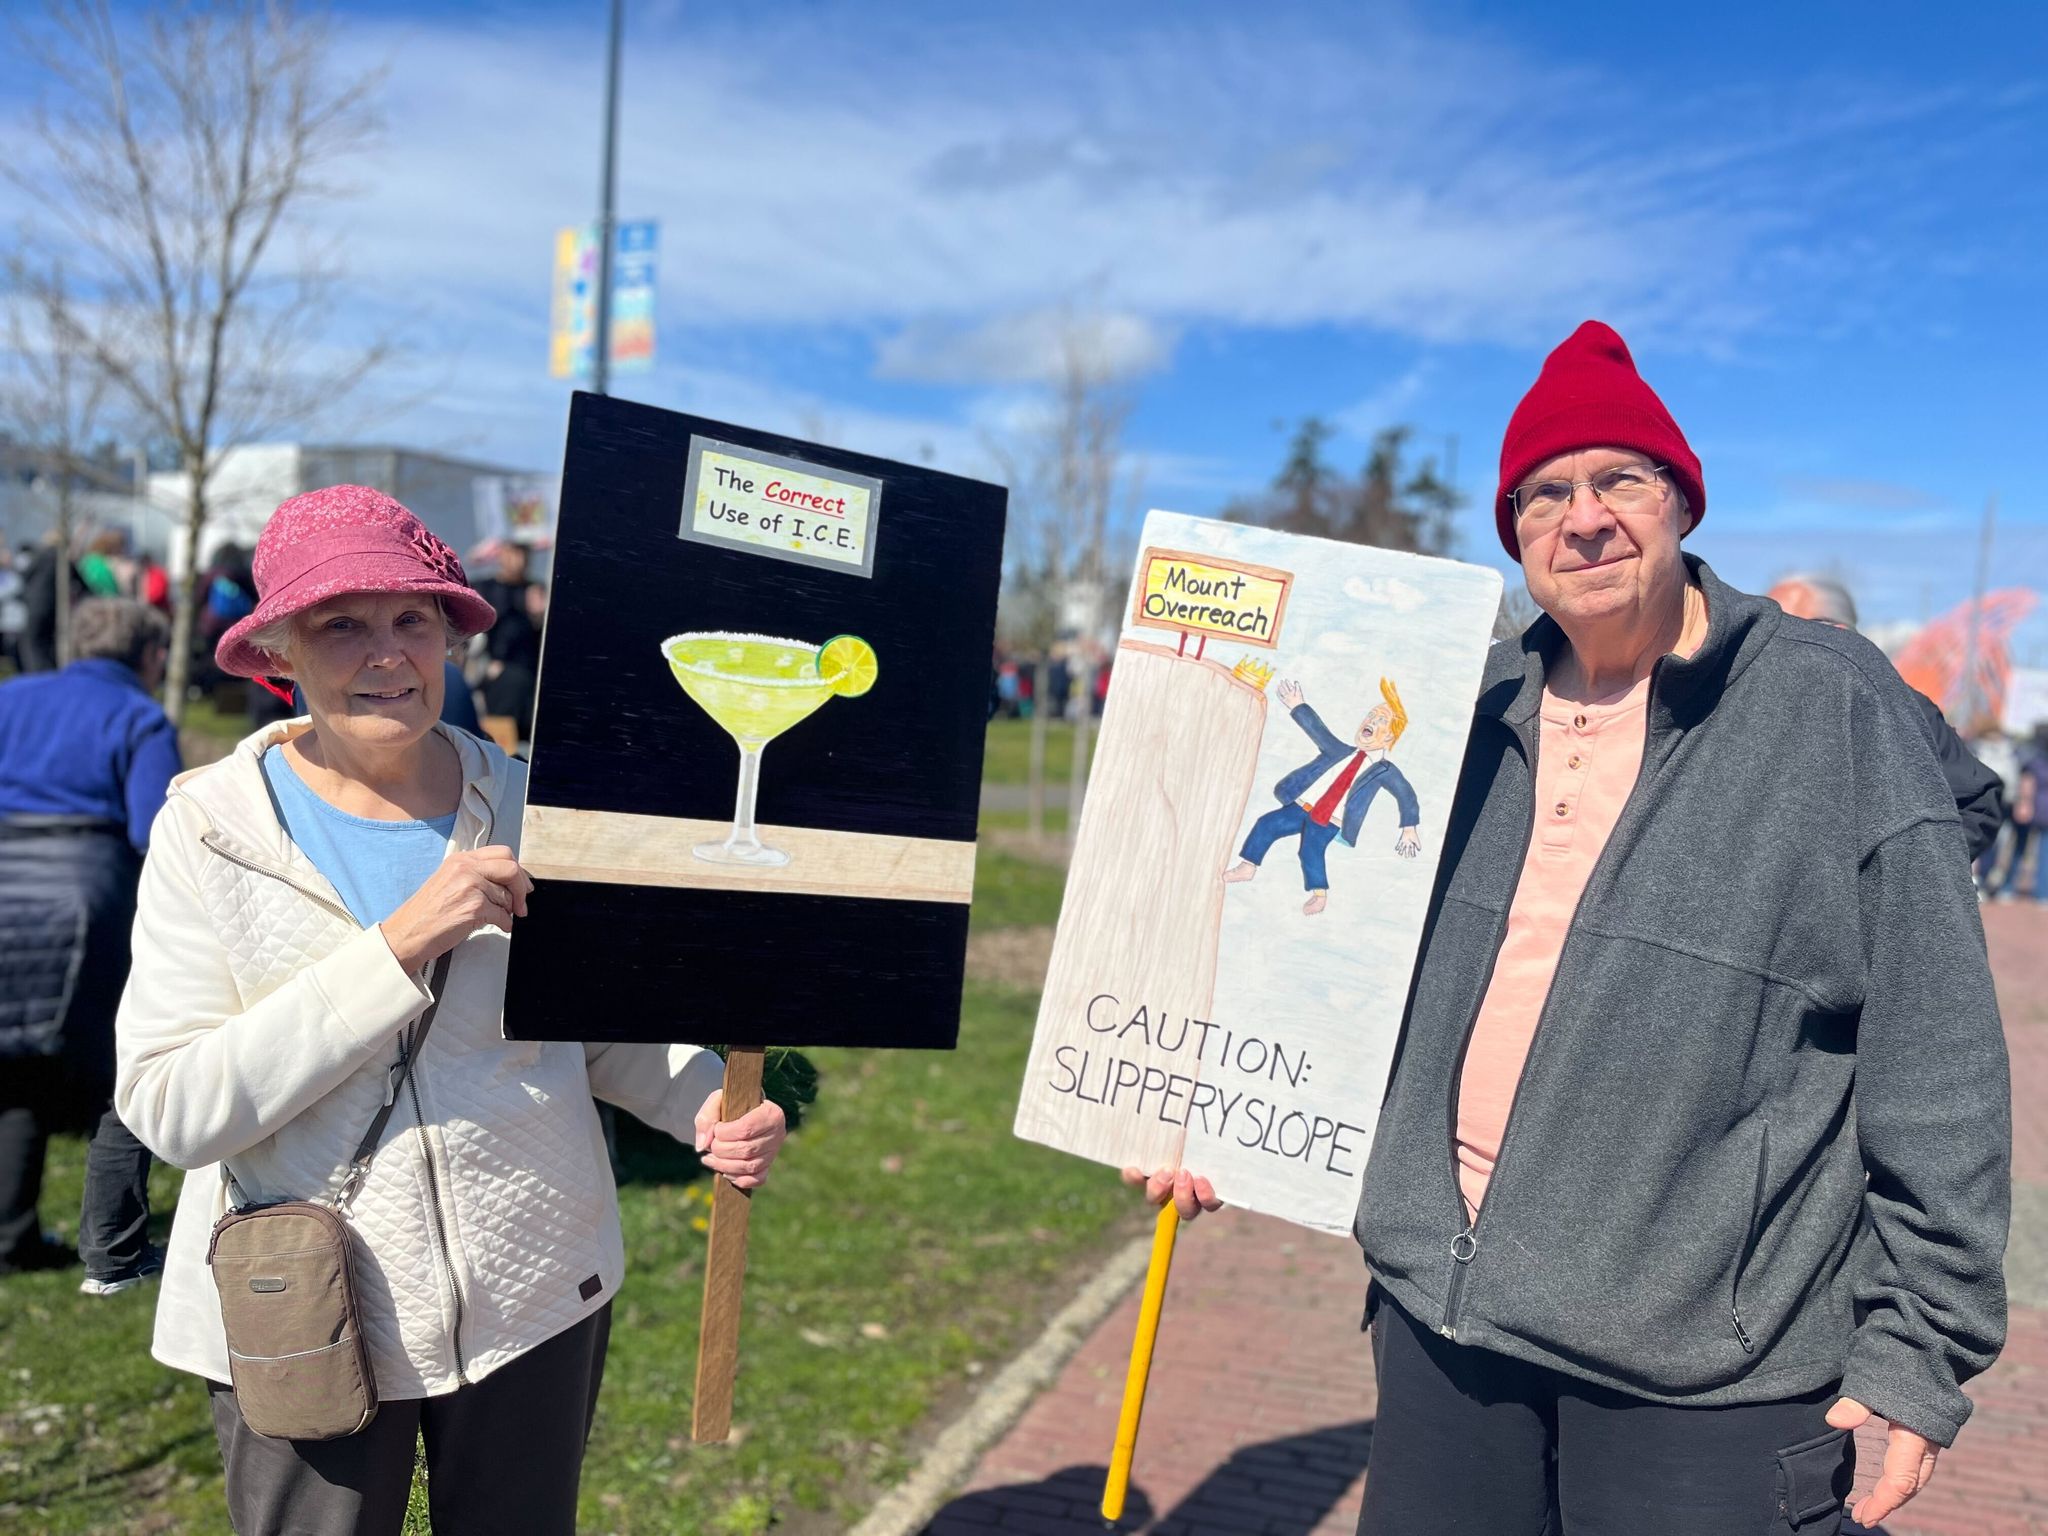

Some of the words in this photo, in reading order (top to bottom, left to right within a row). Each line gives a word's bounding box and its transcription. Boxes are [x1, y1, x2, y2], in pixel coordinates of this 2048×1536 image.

[714, 467, 754, 493] The
[764, 481, 846, 515] Correct
[709, 500, 749, 525] Use
[760, 514, 783, 533] of
[792, 519, 856, 550] I.C.E.
[1164, 566, 1246, 600] Mount
[1145, 593, 1268, 635] Overreach
[1087, 994, 1312, 1088] CAUTION:
